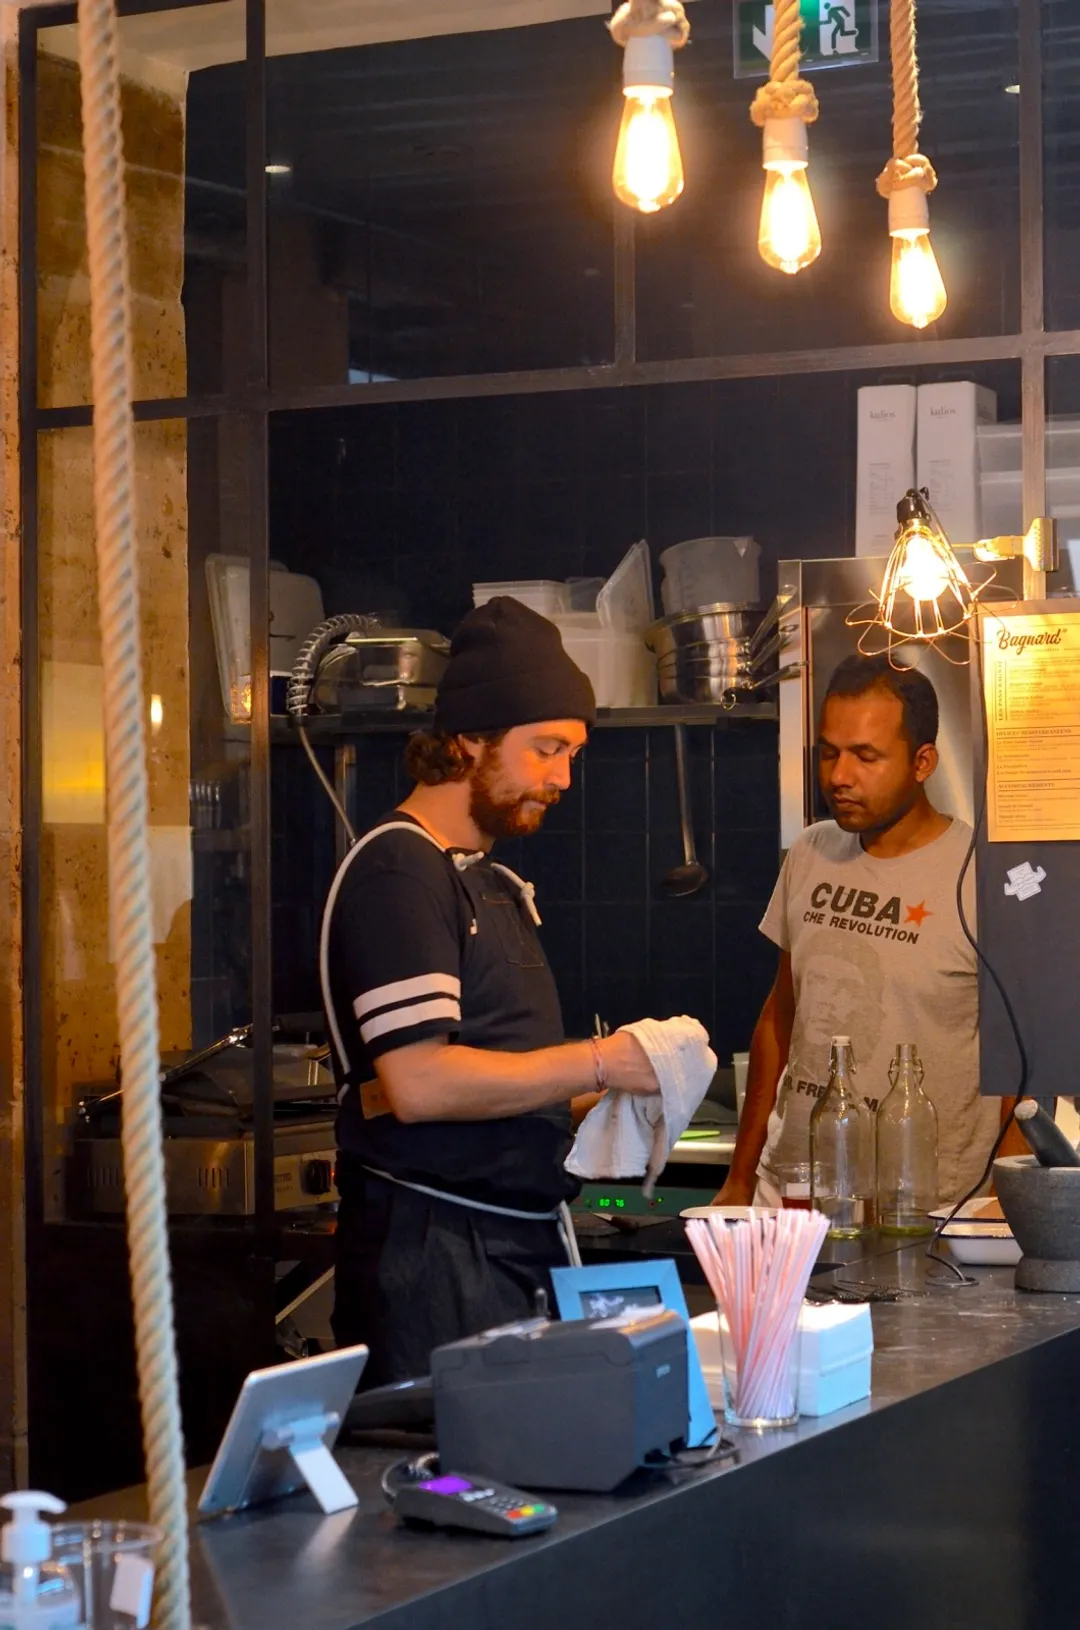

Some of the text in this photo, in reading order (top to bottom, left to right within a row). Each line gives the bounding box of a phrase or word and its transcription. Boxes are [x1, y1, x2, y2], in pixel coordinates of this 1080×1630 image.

[810, 882, 901, 925] CUBA
[803, 911, 919, 945] CHE REVOLUTION
